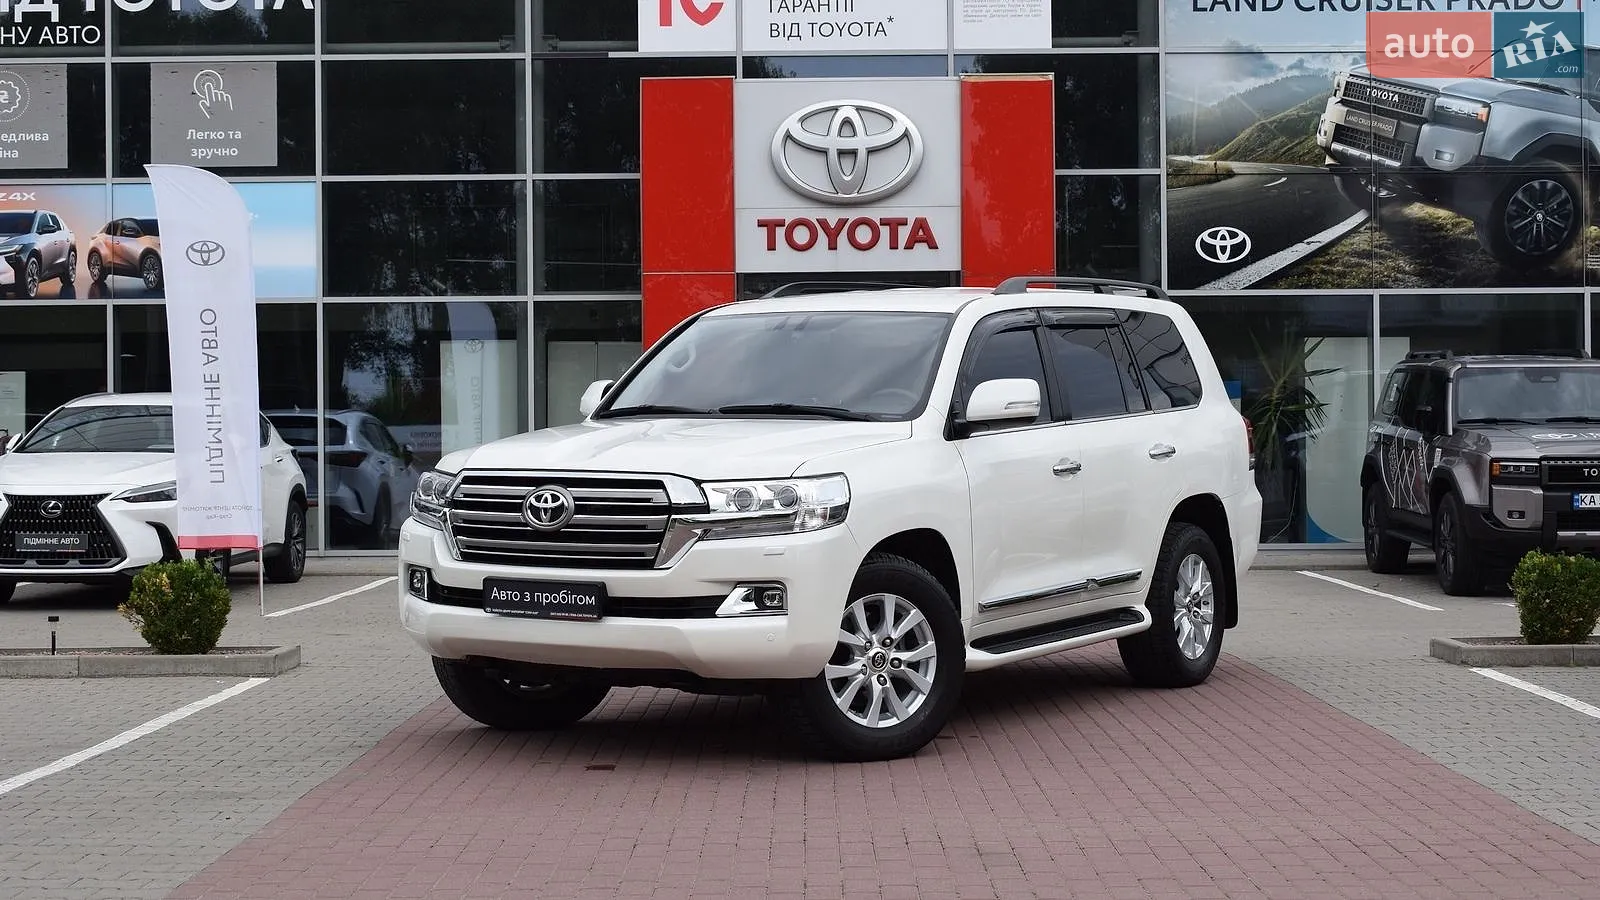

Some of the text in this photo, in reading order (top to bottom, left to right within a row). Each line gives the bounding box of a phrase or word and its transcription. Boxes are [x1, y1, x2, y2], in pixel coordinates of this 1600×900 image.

[38, 25, 101, 44] АВТО
[769, 22, 802, 41] ВІД
[1366, 88, 1399, 103] TOYOTA
[186, 129, 242, 140] Легко та
[191, 147, 239, 159] зручно
[757, 216, 939, 252] TOYOTA
[23, 537, 80, 545] ПІДМІННЕ АВТО
[490, 586, 596, 606] Авто з пробігом
